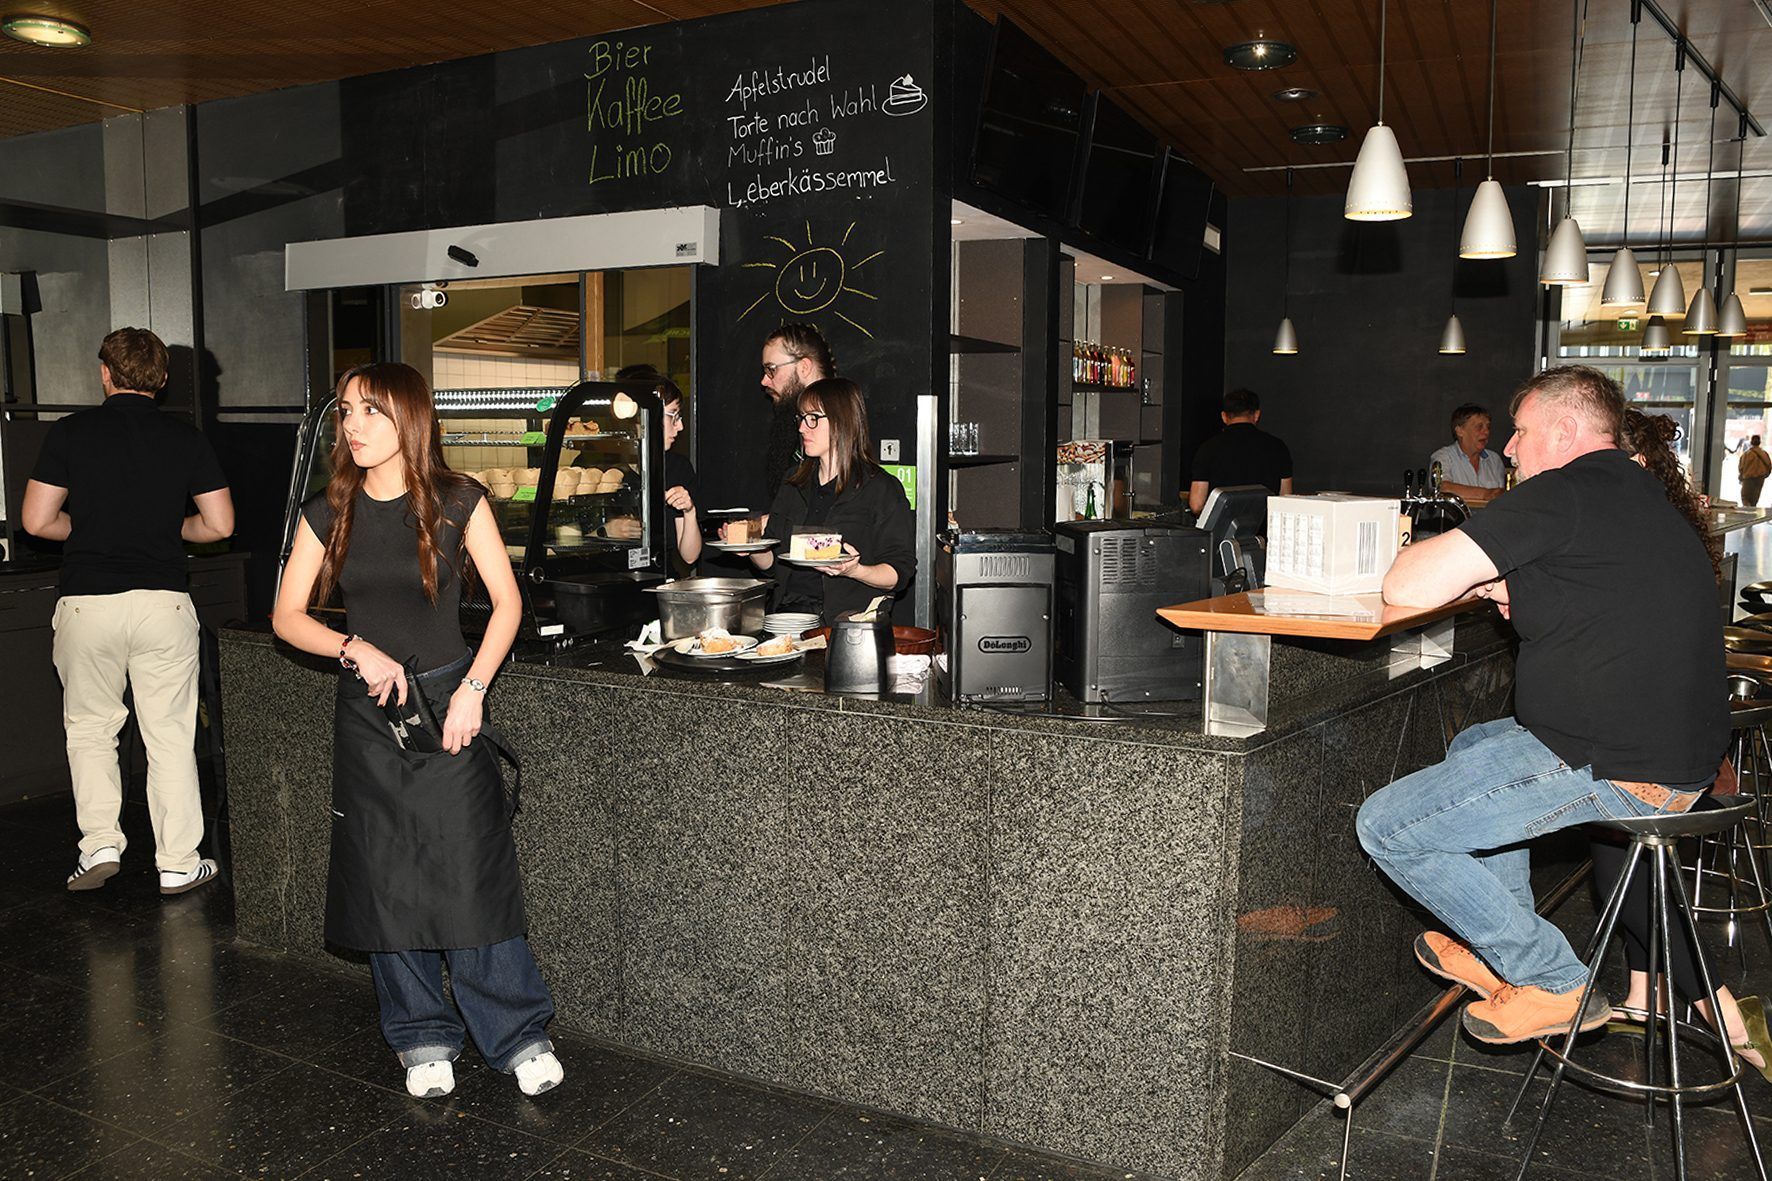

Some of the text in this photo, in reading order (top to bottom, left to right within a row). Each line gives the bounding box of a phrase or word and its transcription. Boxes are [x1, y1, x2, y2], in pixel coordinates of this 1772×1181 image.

[584, 41, 652, 79] Bier
[725, 55, 830, 111] Apfelstrudel
[587, 76, 684, 135] Kaffee
[727, 84, 877, 139] Torte nach Wahl
[589, 143, 672, 185] Limo
[728, 136, 803, 167] Muffin's
[728, 156, 896, 207] Leberkässemmel
[897, 467, 911, 483] 01
